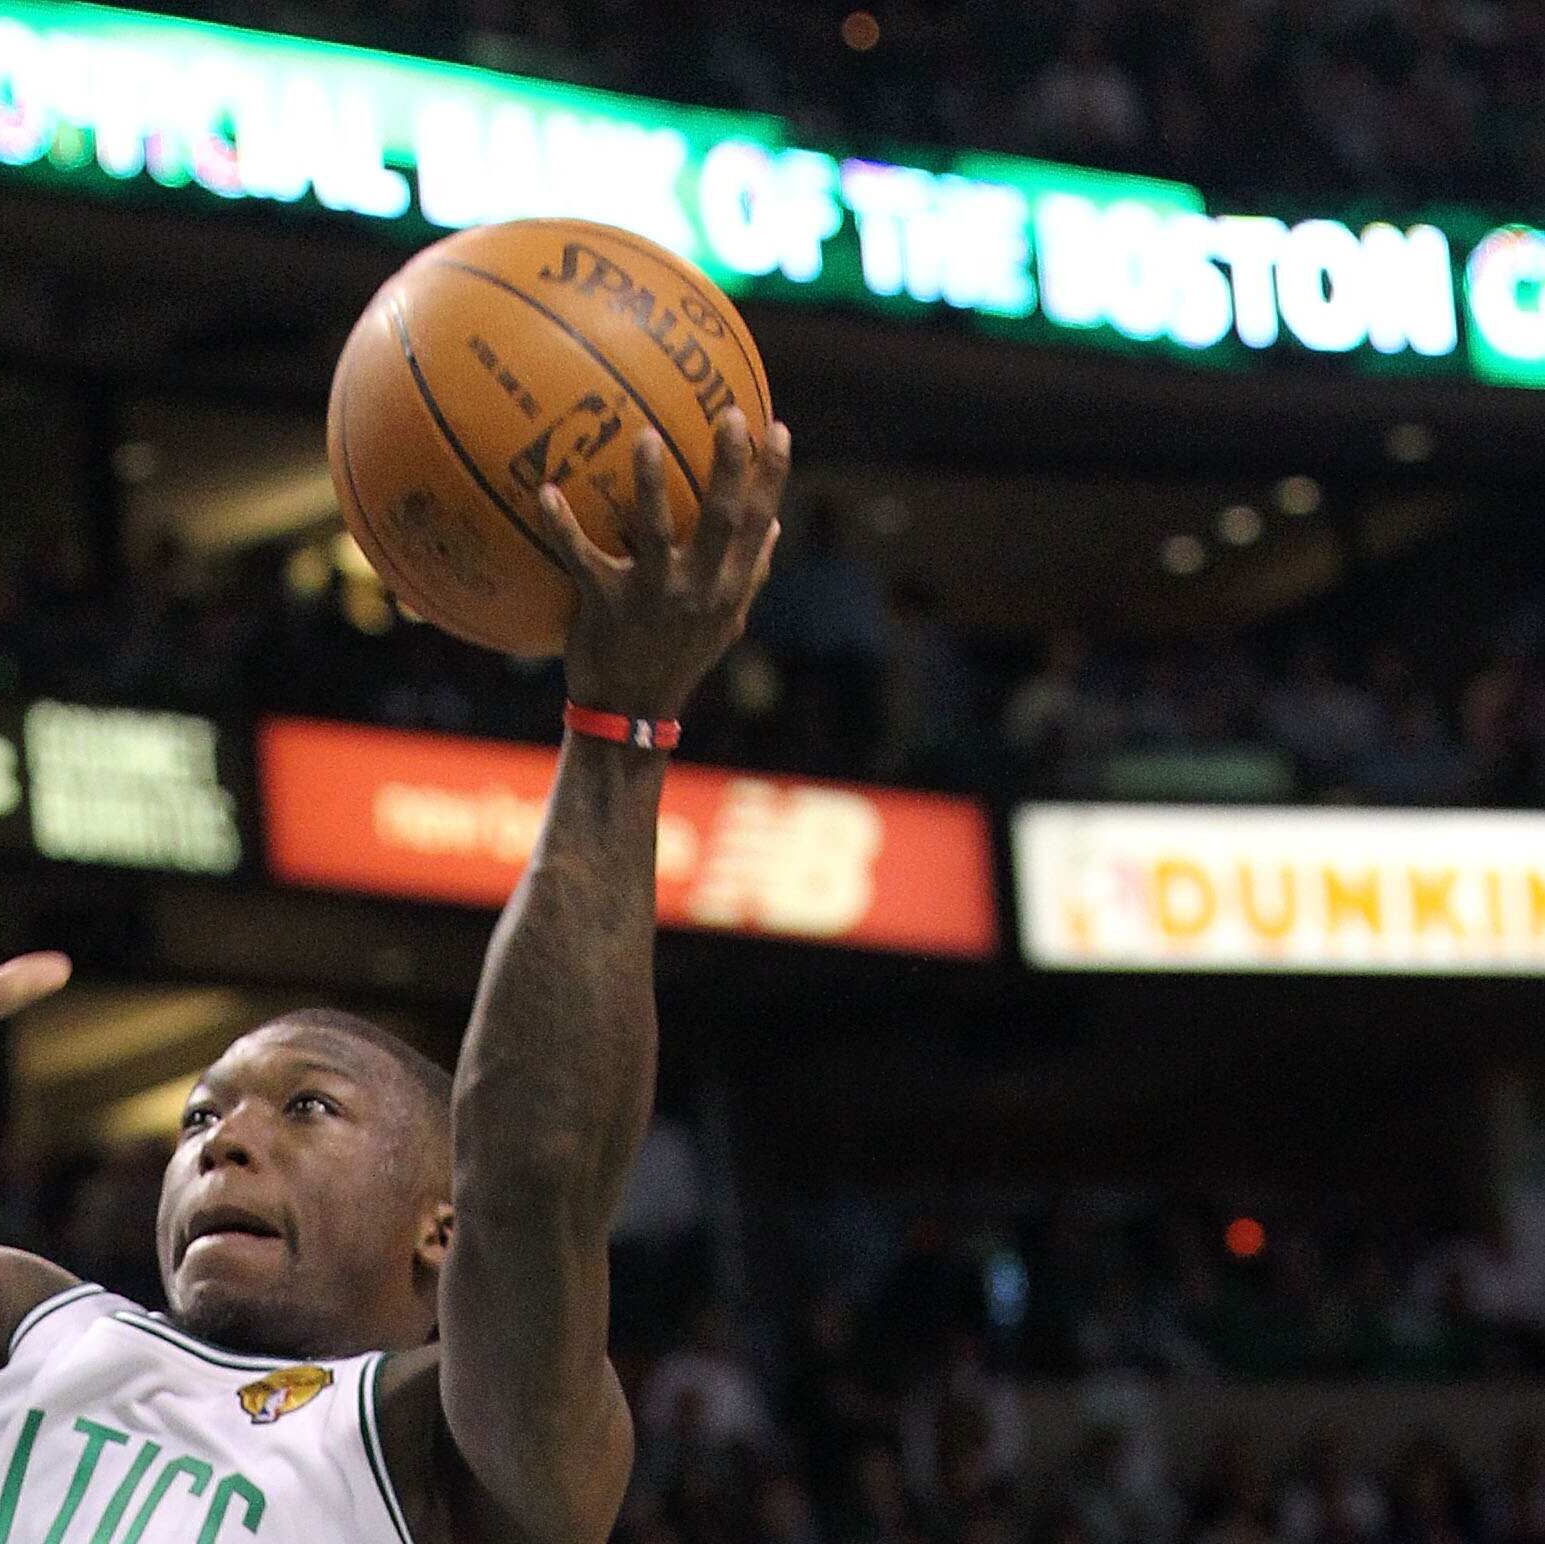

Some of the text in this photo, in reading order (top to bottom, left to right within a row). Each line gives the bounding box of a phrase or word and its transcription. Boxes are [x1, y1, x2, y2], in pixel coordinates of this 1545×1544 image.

[537, 242, 740, 424] SPALDI
[698, 140, 844, 283] OF
[844, 158, 1036, 318] THE
[1038, 193, 1456, 356] BOSTON
